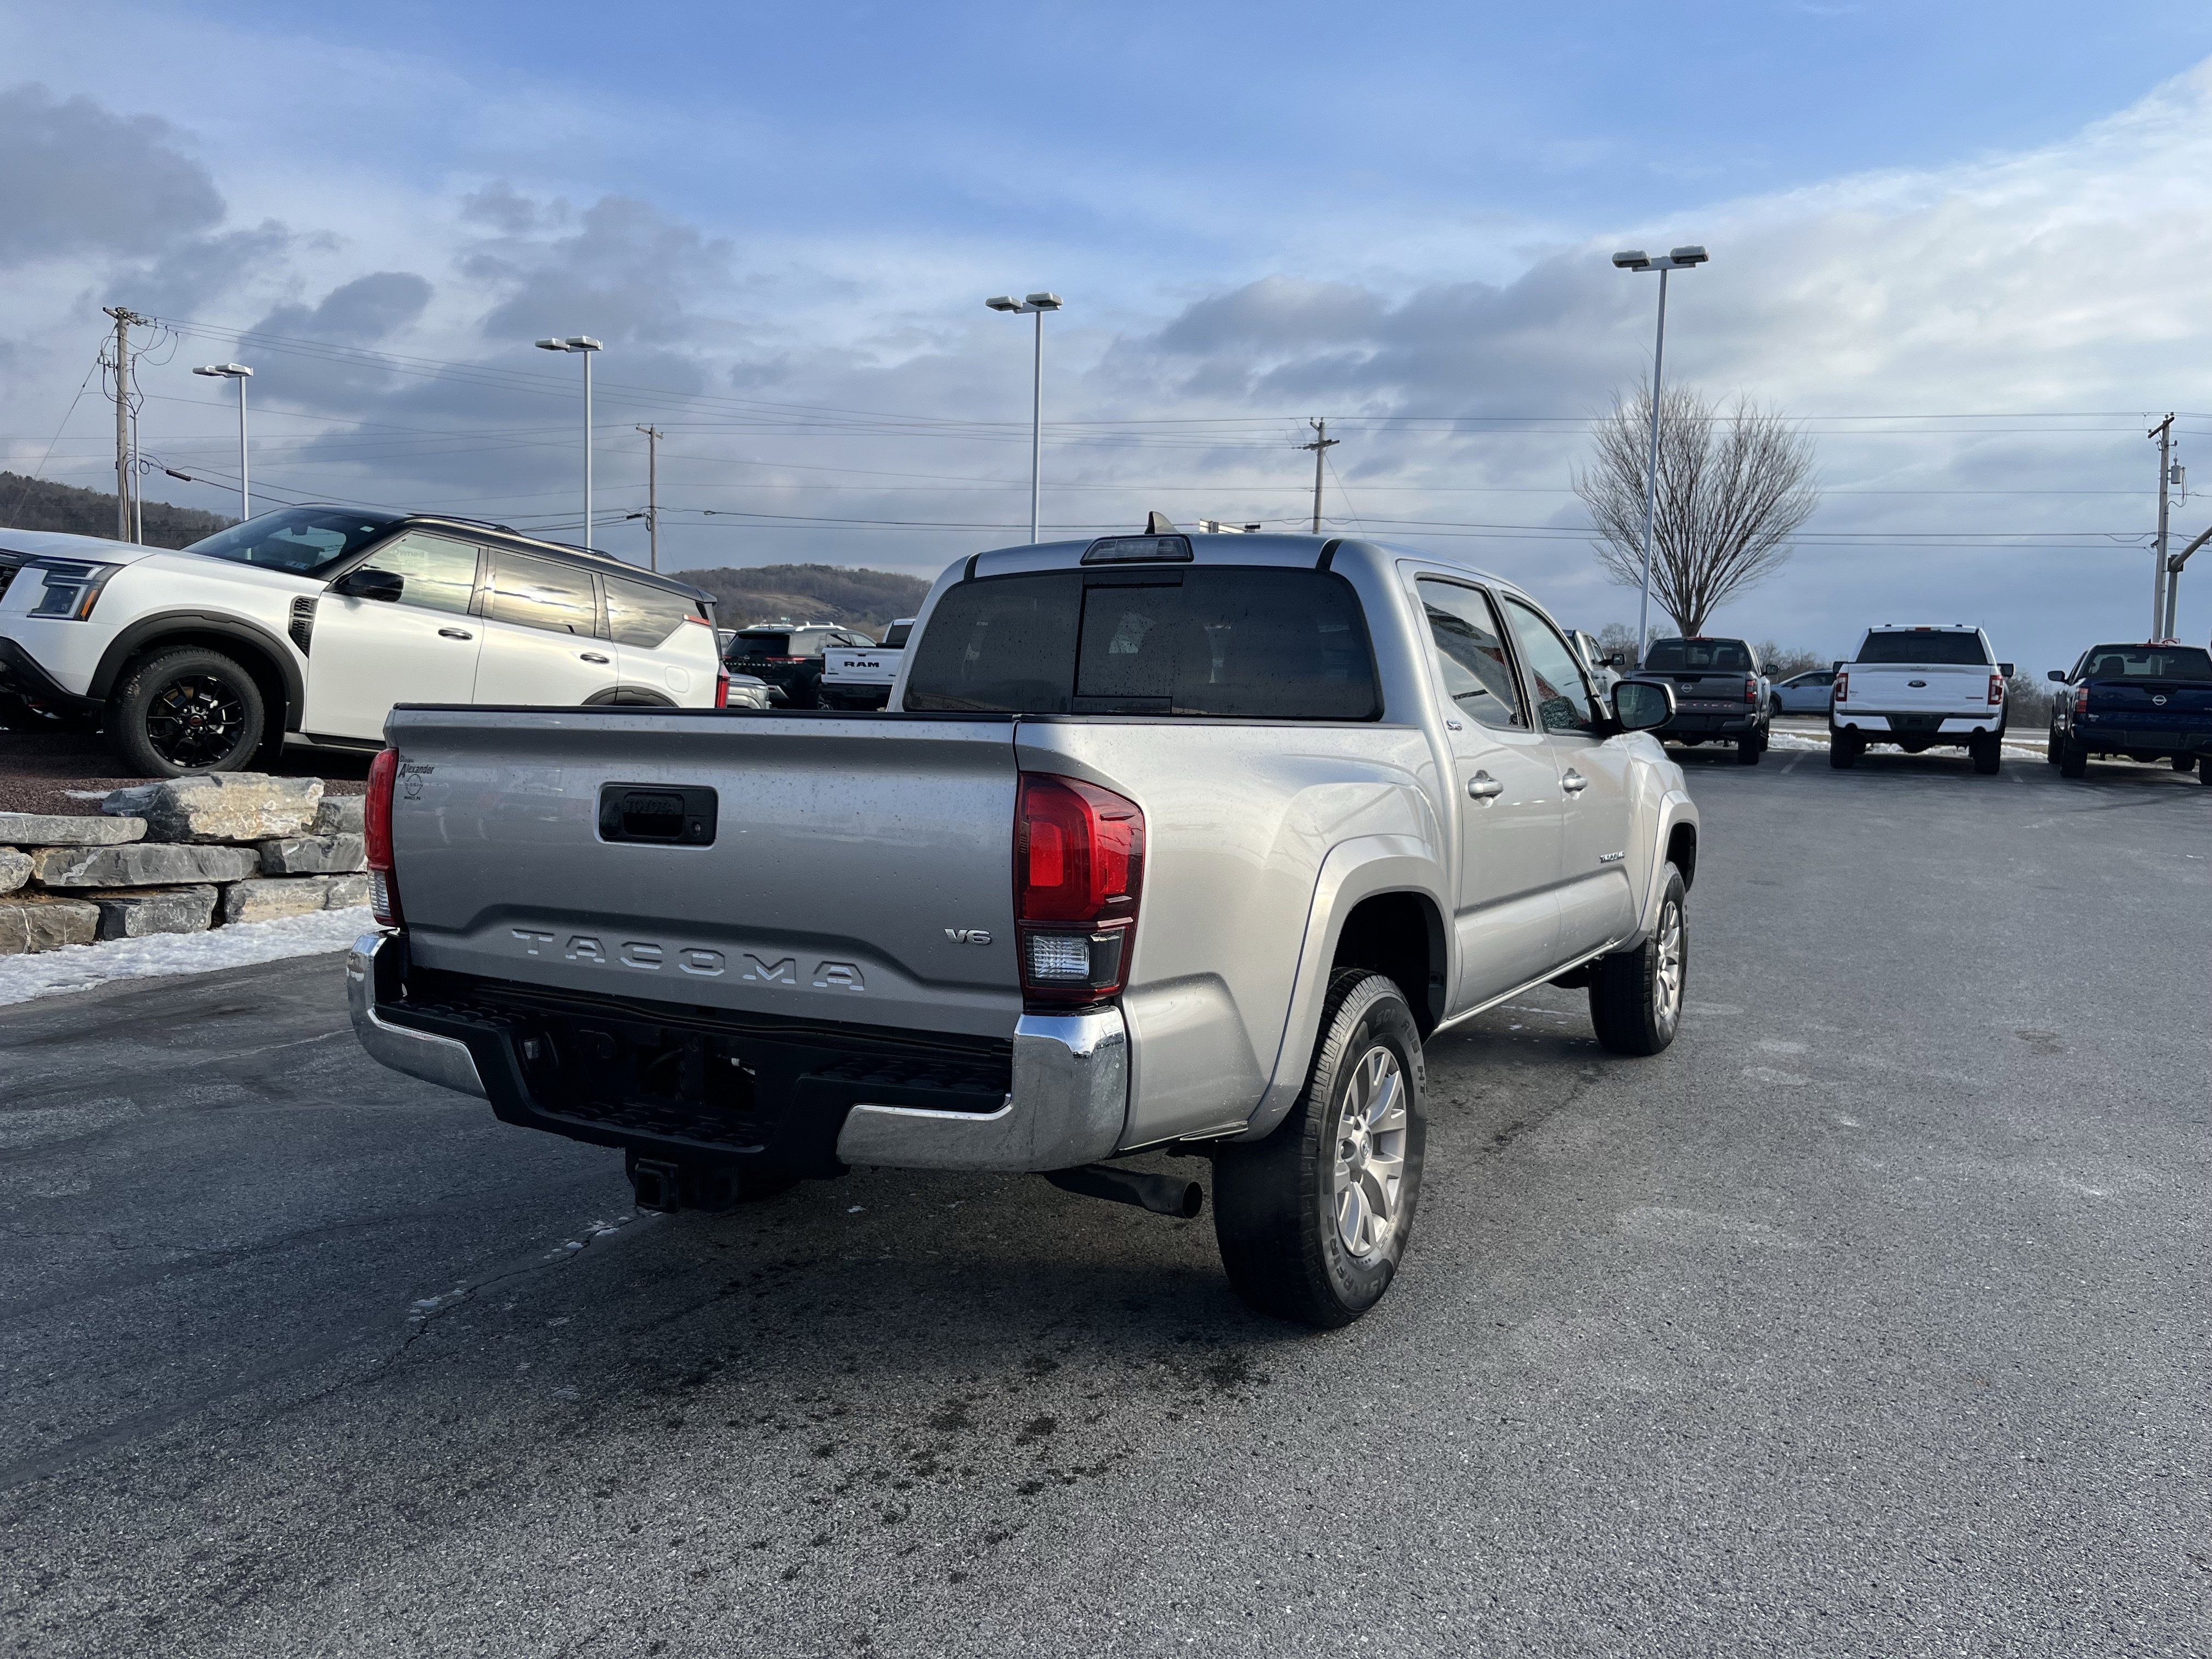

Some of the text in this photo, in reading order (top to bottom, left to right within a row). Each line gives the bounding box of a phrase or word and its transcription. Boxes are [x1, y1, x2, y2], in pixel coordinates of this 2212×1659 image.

[398, 763, 435, 777] Alexander
[944, 928, 992, 945] V6
[511, 929, 865, 991] TACOMA
